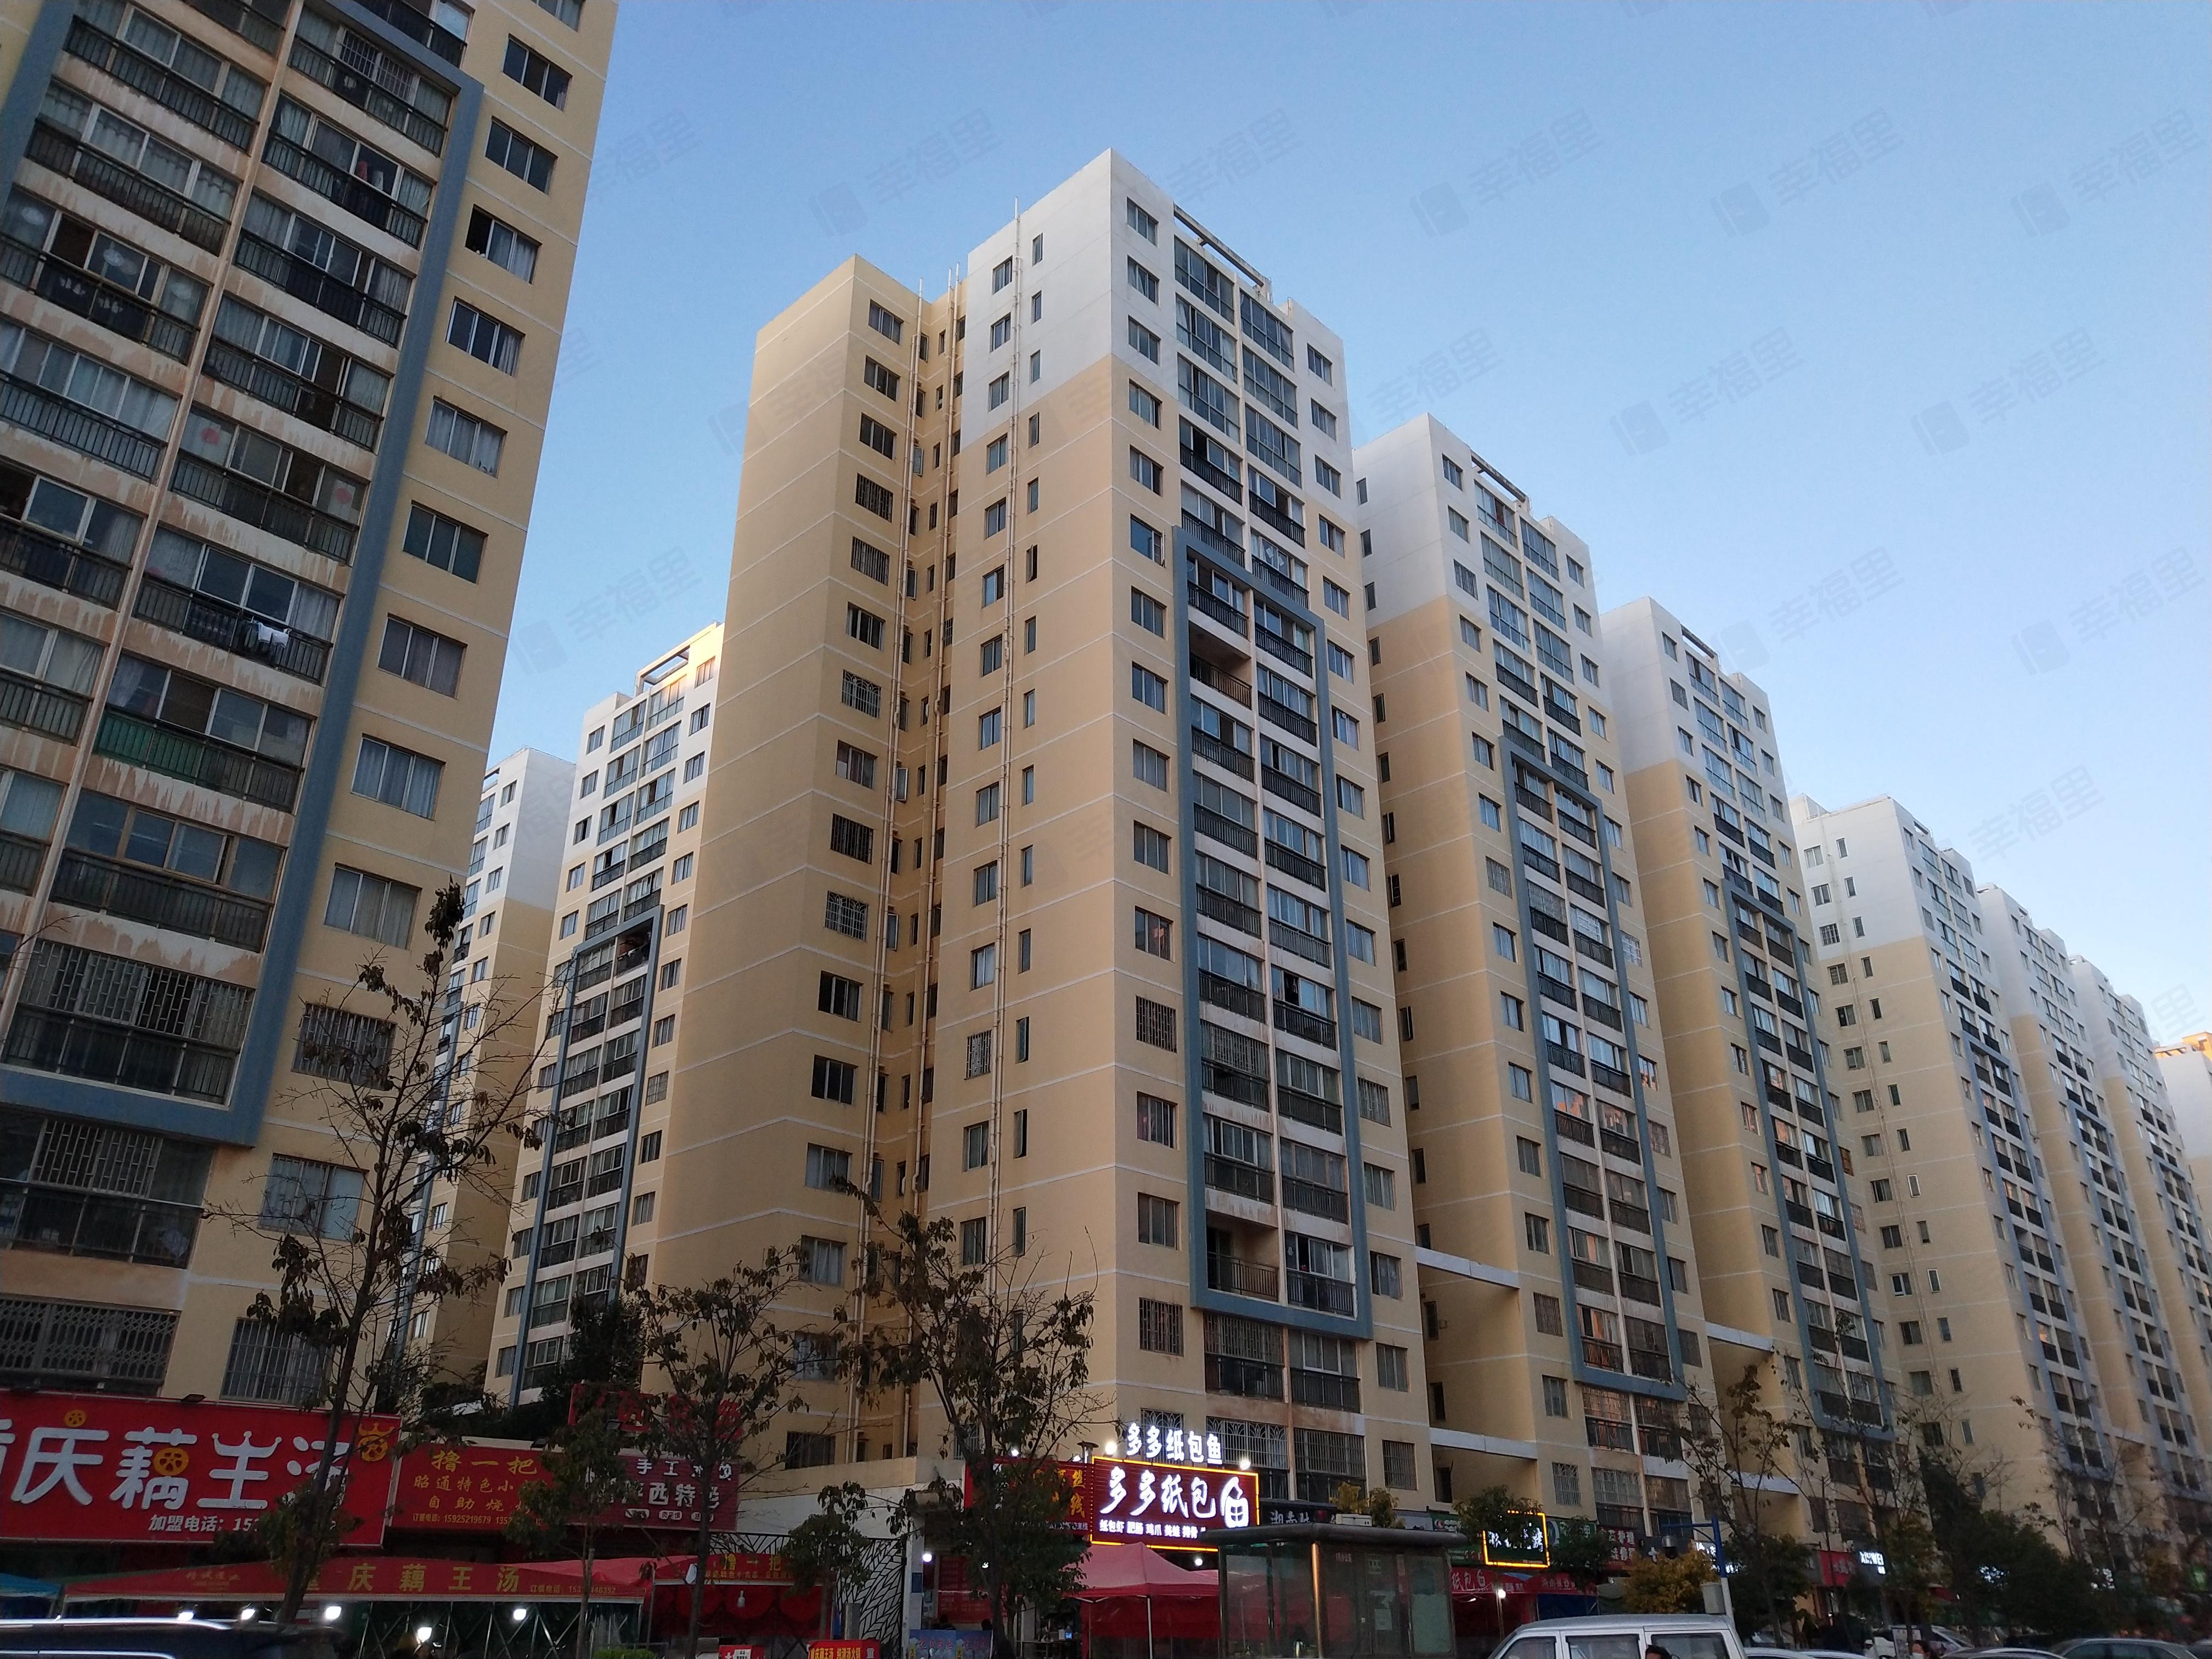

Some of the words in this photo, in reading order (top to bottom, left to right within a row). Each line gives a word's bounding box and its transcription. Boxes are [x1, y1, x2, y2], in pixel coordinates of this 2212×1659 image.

[1127, 1423, 1223, 1465] 多多纸包鱼
[431, 1449, 538, 1476] 撸一把
[1099, 1465, 1249, 1528] 多多纸包鱼
[443, 1514, 492, 1525] 15925219679
